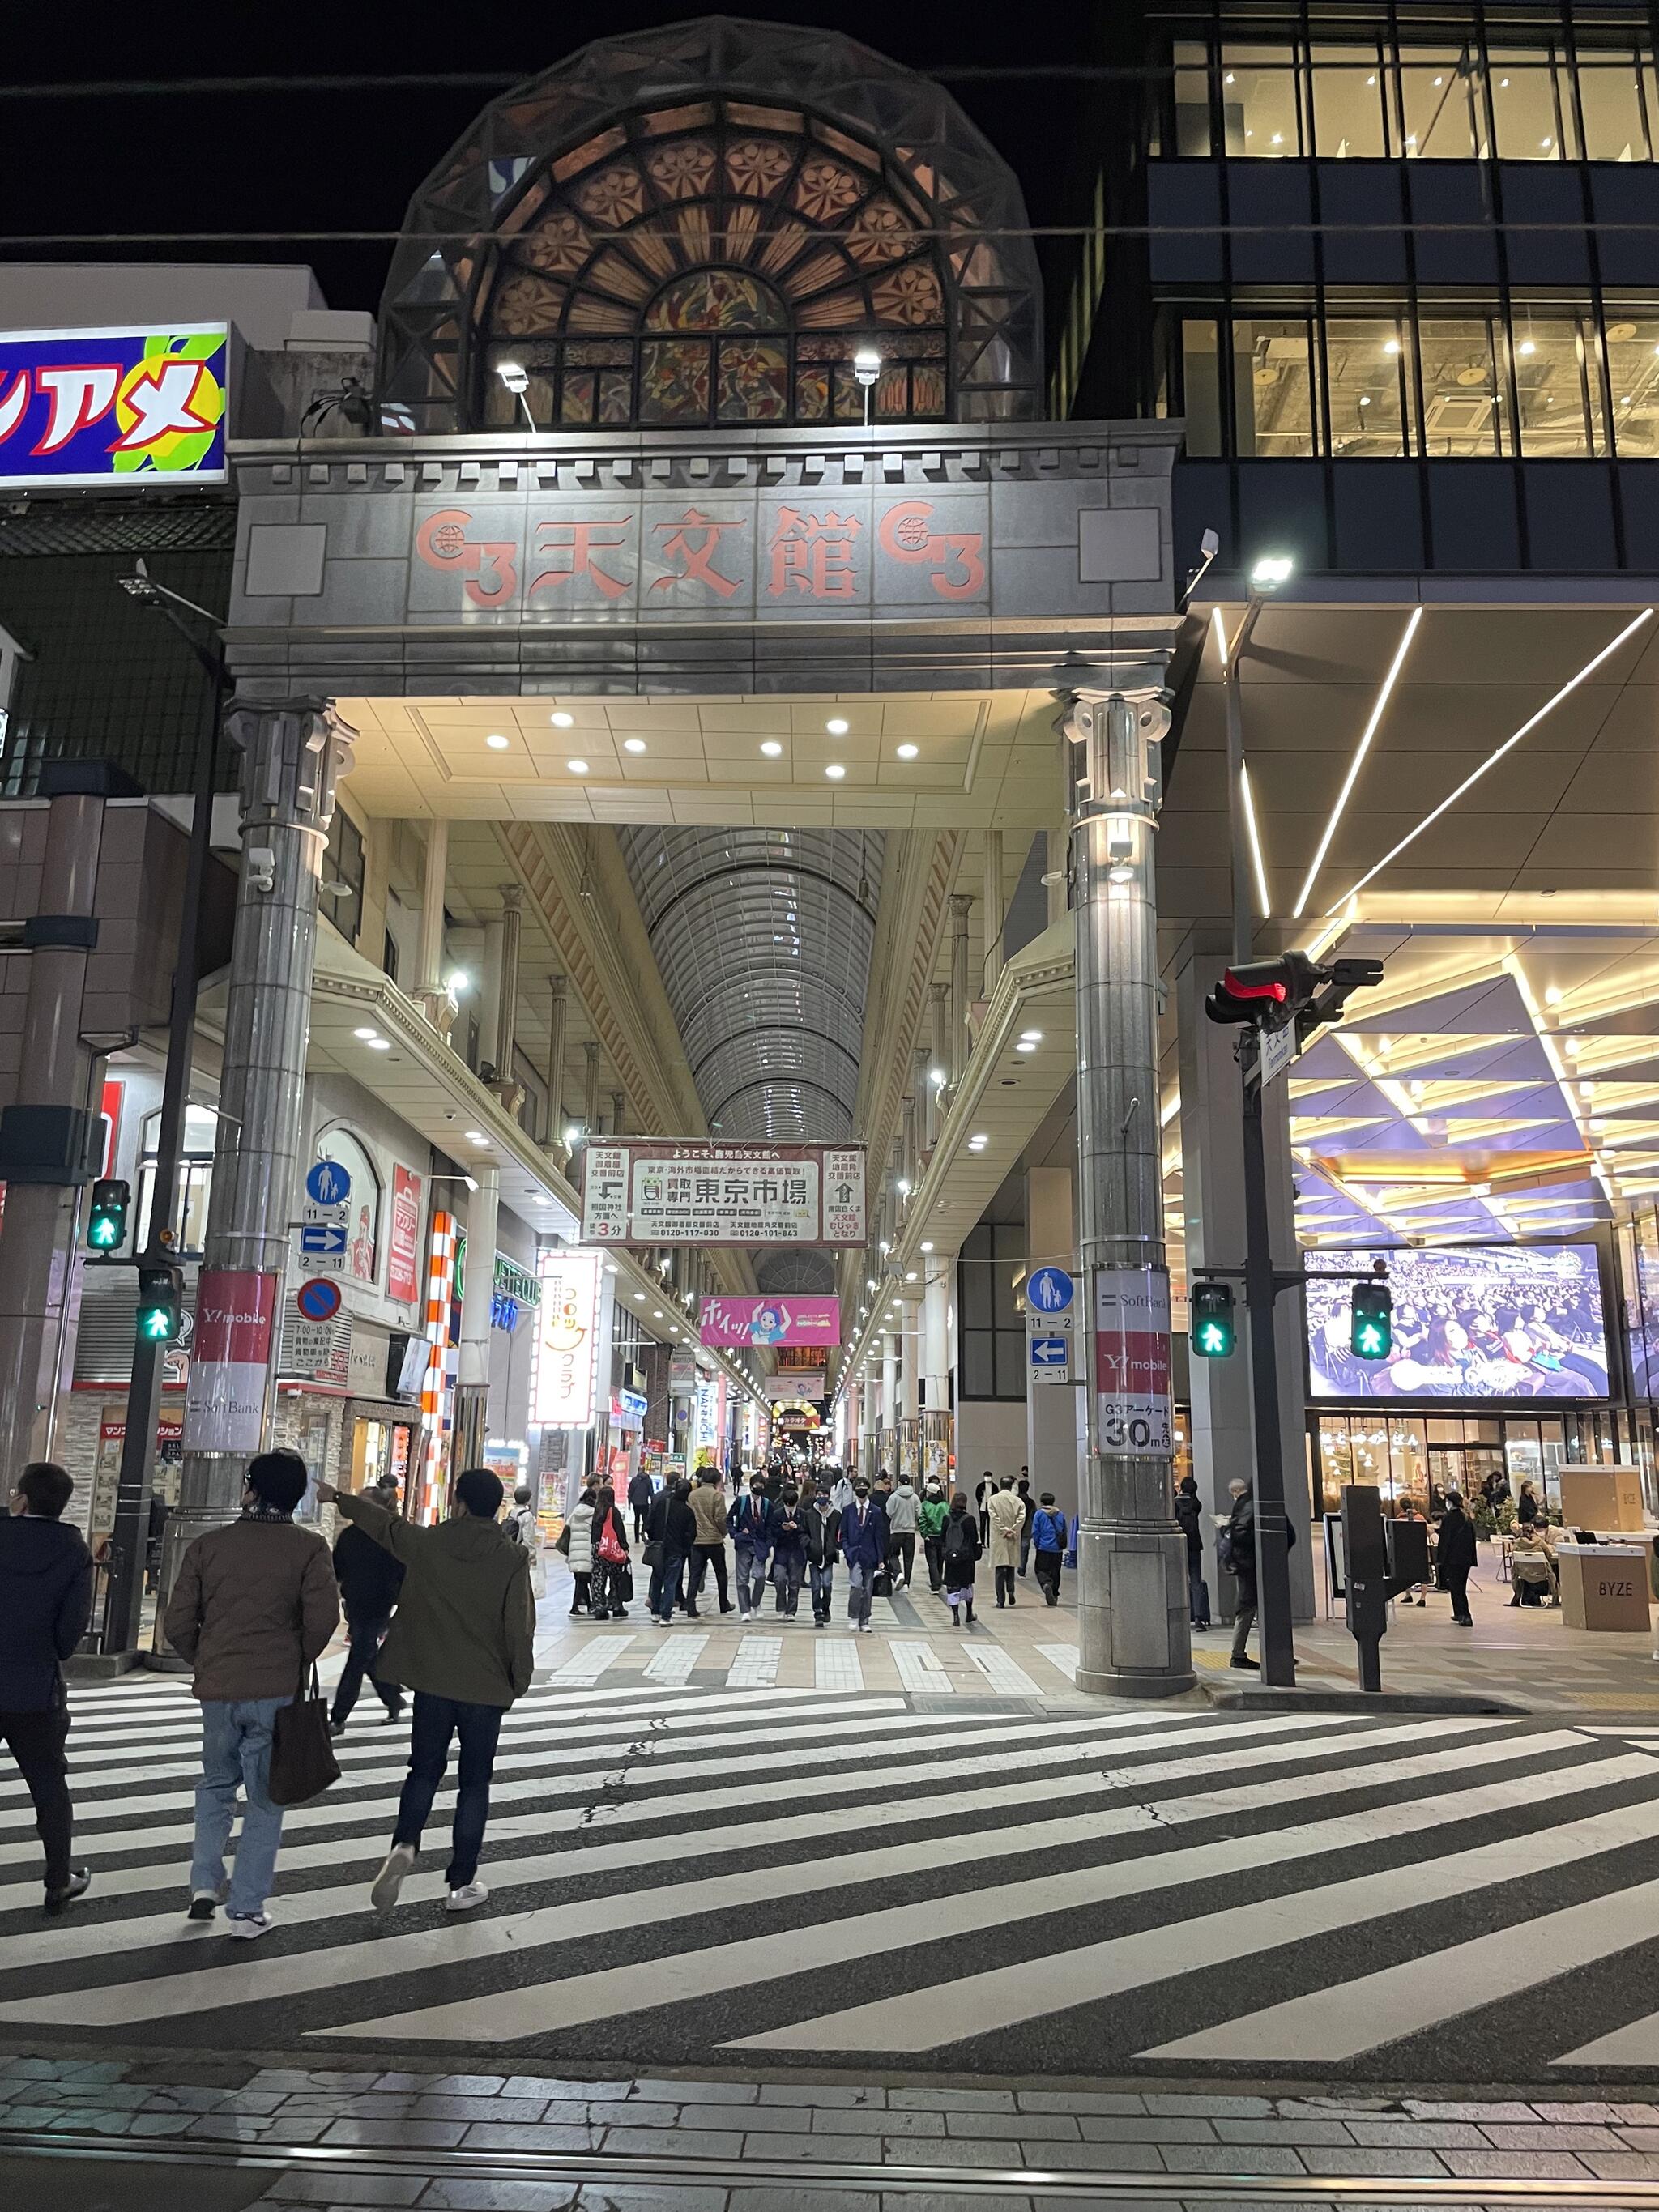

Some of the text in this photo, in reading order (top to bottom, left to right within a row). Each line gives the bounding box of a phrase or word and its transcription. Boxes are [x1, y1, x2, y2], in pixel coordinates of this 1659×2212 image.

[528, 505, 864, 599] 天文館
[595, 1151, 621, 1159] 天文館
[672, 1149, 781, 1160] ようこそ、鹿児島天文館へ
[832, 1154, 857, 1162] 天文館
[667, 1178, 691, 1190] 買取
[667, 1191, 691, 1204] 専門
[695, 1178, 808, 1204] 東京市場
[598, 1222, 609, 1237] 3
[611, 1225, 622, 1237] 分
[833, 1230, 856, 1238] となり
[296, 1358, 329, 1367] ここから
[203, 1400, 259, 1415] SoftBank
[699, 1387, 710, 1443] NANNICHI
[1598, 1582, 1634, 1596] BYZE
